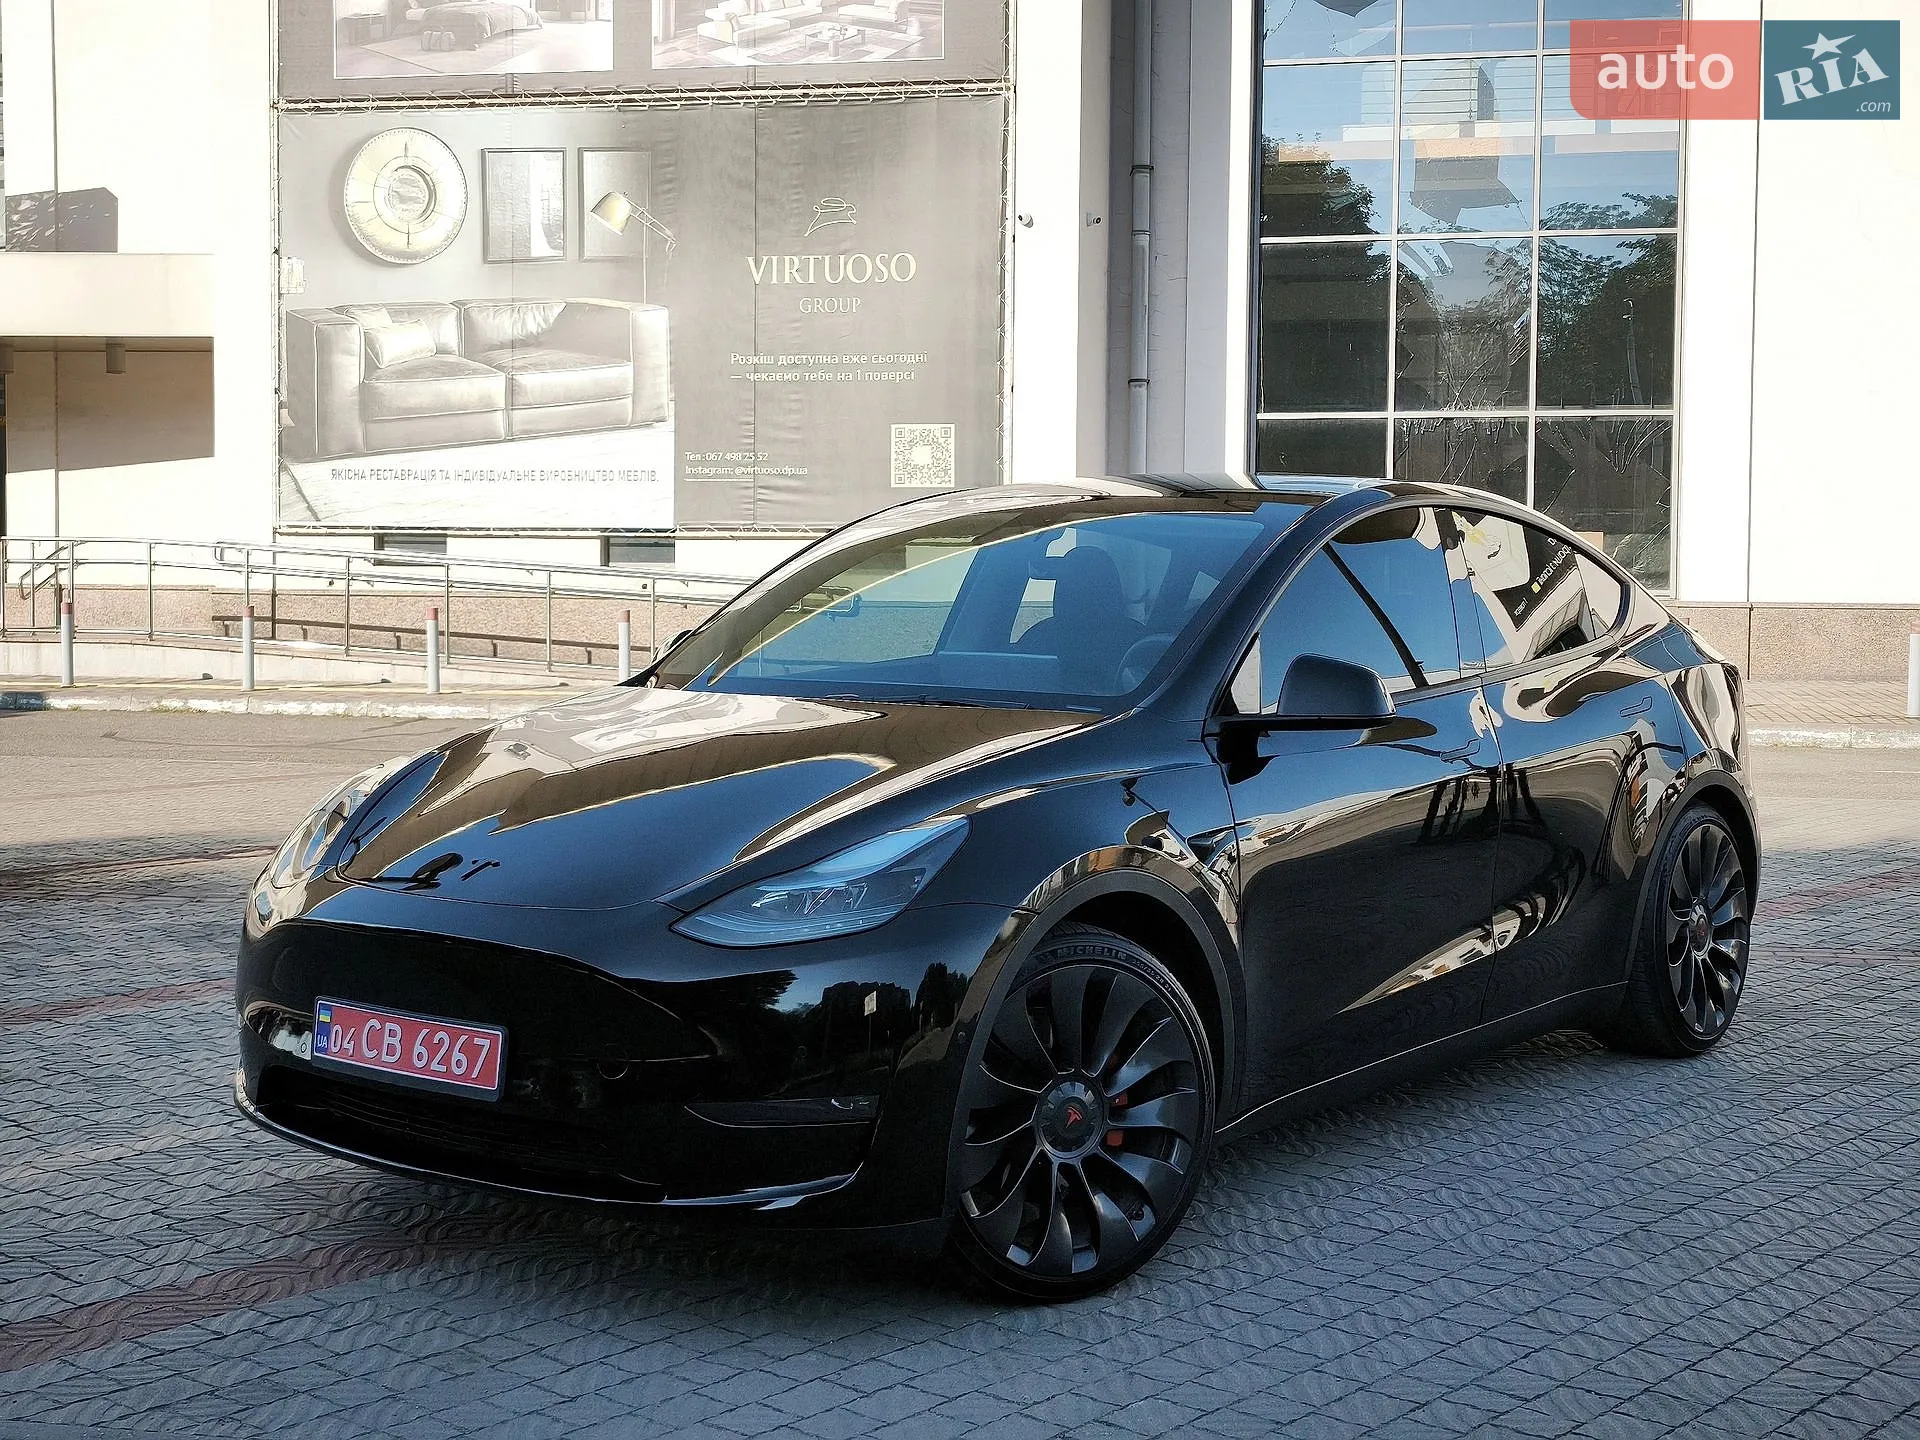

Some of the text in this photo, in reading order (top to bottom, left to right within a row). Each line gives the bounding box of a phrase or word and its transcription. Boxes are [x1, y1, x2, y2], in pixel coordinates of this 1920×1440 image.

[745, 252, 918, 285] VIRTUOSO
[799, 297, 862, 314] GROUP
[730, 351, 928, 367] Розкіш доступна вже сьогодні
[745, 371, 800, 382] чекаємо
[803, 370, 833, 381] тебе
[836, 371, 852, 381] на
[856, 370, 862, 381] 1
[865, 370, 915, 382] поверсі
[724, 452, 741, 461] 498
[755, 452, 768, 461] 52
[331, 468, 367, 481] ЯКІСНА
[369, 468, 437, 482] РЕСТАВРАЦІЯ
[439, 469, 450, 481] ТА
[454, 469, 536, 483] ІНДИВІДУАЛЬНЕ
[539, 469, 615, 483] ВИРОБНИЦТВО
[685, 465, 808, 477] Instagram: @virtuoso.dp.ua
[1056, 944, 1128, 961] MICHELIN
[317, 1034, 328, 1049] UA
[330, 1023, 356, 1057] 04
[412, 1028, 491, 1079] 6267
